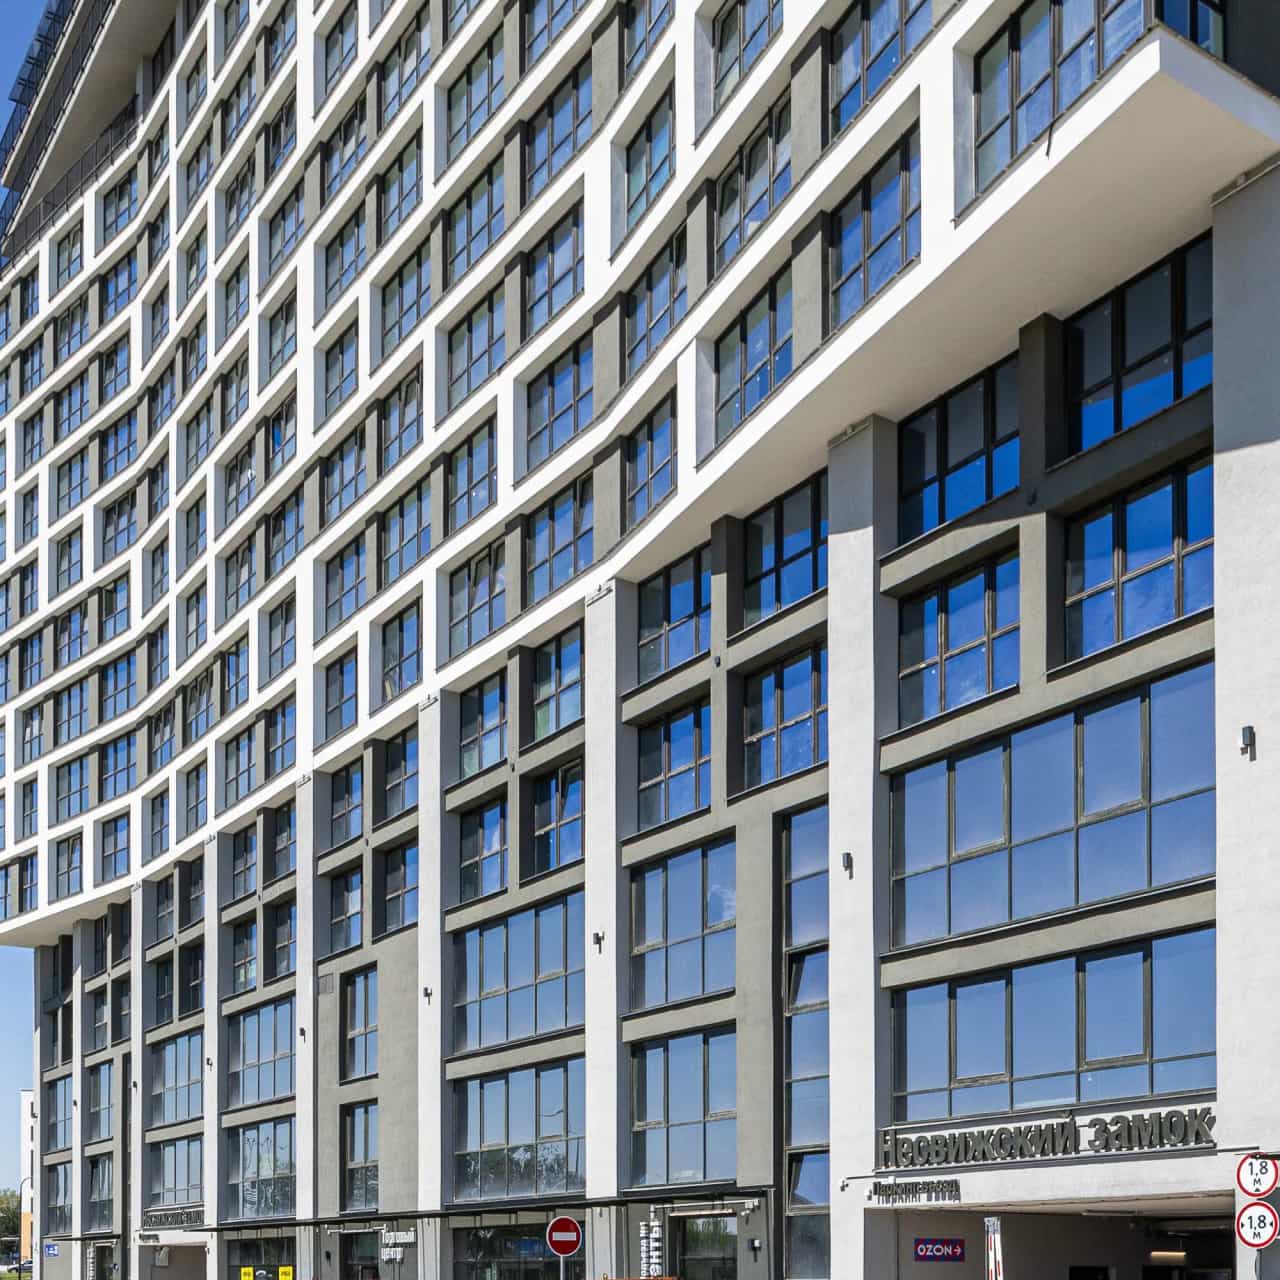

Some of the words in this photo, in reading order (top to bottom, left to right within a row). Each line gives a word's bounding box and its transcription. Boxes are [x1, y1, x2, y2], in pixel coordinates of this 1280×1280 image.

[878, 1112, 1081, 1170] Несвижский
[1087, 1106, 1218, 1151] замок
[1247, 1160, 1269, 1177] 1,8
[1247, 1214, 1267, 1230] 1,8
[917, 1244, 952, 1256] OZON
